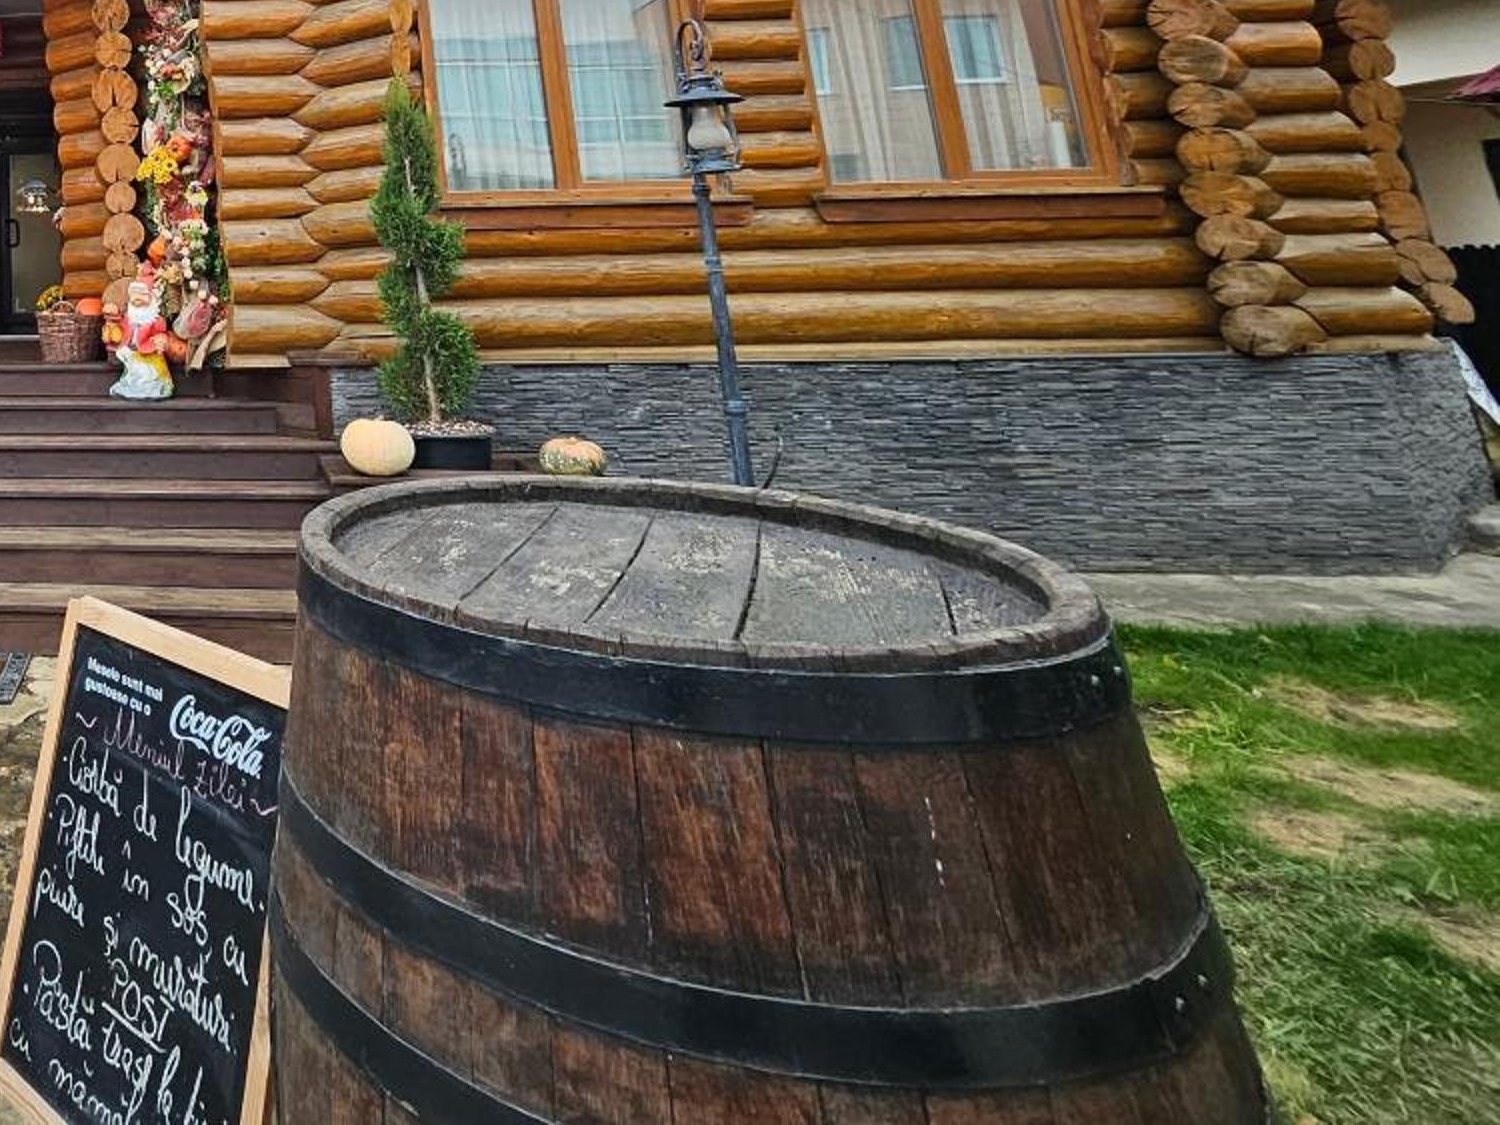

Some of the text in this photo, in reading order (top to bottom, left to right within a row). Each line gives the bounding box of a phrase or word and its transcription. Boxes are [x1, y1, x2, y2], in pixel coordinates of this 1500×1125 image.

[129, 697, 143, 712] cu
[143, 704, 151, 716] o
[104, 707, 184, 780] Meniul
[133, 767, 158, 842] de
[223, 934, 249, 986] cu
[10, 1017, 32, 1063] cu
